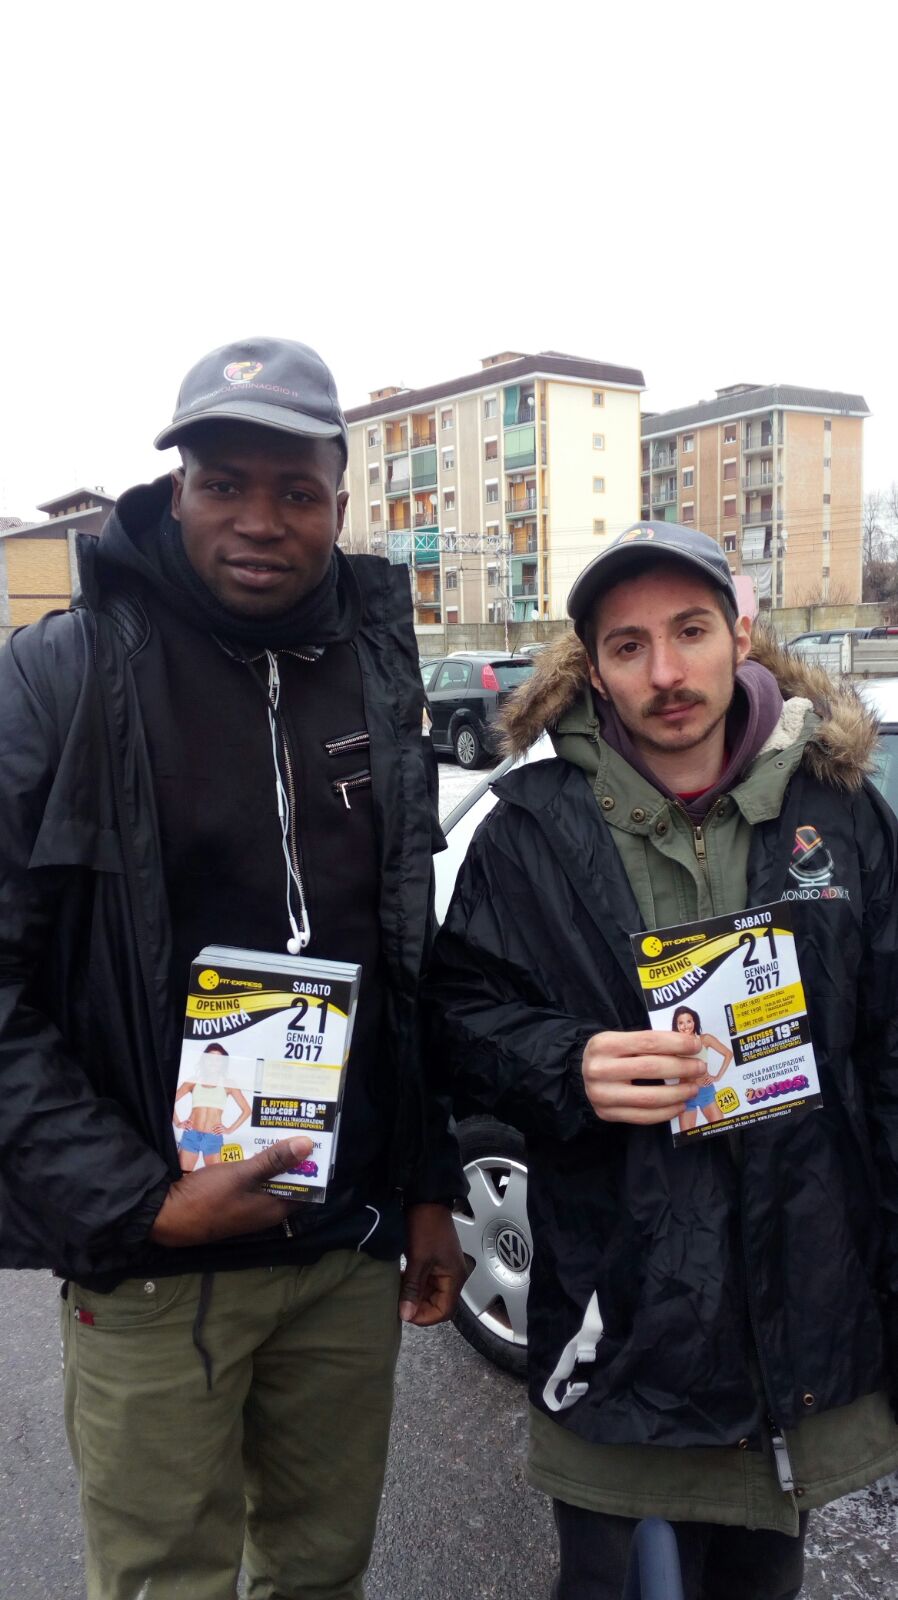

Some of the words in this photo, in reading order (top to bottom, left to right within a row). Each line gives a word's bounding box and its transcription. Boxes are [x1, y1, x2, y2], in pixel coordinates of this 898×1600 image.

[734, 911, 772, 931] SABATO
[739, 927, 777, 968] 21
[649, 957, 692, 980] OPENING
[744, 961, 779, 979] GENNAIO
[292, 981, 331, 996] SABATO
[652, 965, 707, 1005] NOVARA
[745, 970, 780, 996] 2017
[196, 999, 240, 1011] OPENING
[192, 1008, 251, 1035] NOVARA
[287, 997, 328, 1033] 21
[286, 1032, 324, 1045] GENNAIO
[741, 1036, 774, 1052] LOW-COST
[747, 1029, 773, 1043] FITNESS
[284, 1042, 323, 1062] 2017
[742, 1072, 755, 1080] CON
[762, 1056, 806, 1074] PARTECIPAZIONE
[751, 1066, 793, 1085] STRAORDINARIA
[269, 1100, 299, 1109] FITNESS
[719, 1093, 736, 1108] 24H
[260, 1107, 298, 1116] LOW-COST
[254, 1137, 266, 1146] CON
[222, 1151, 241, 1162] 24H
